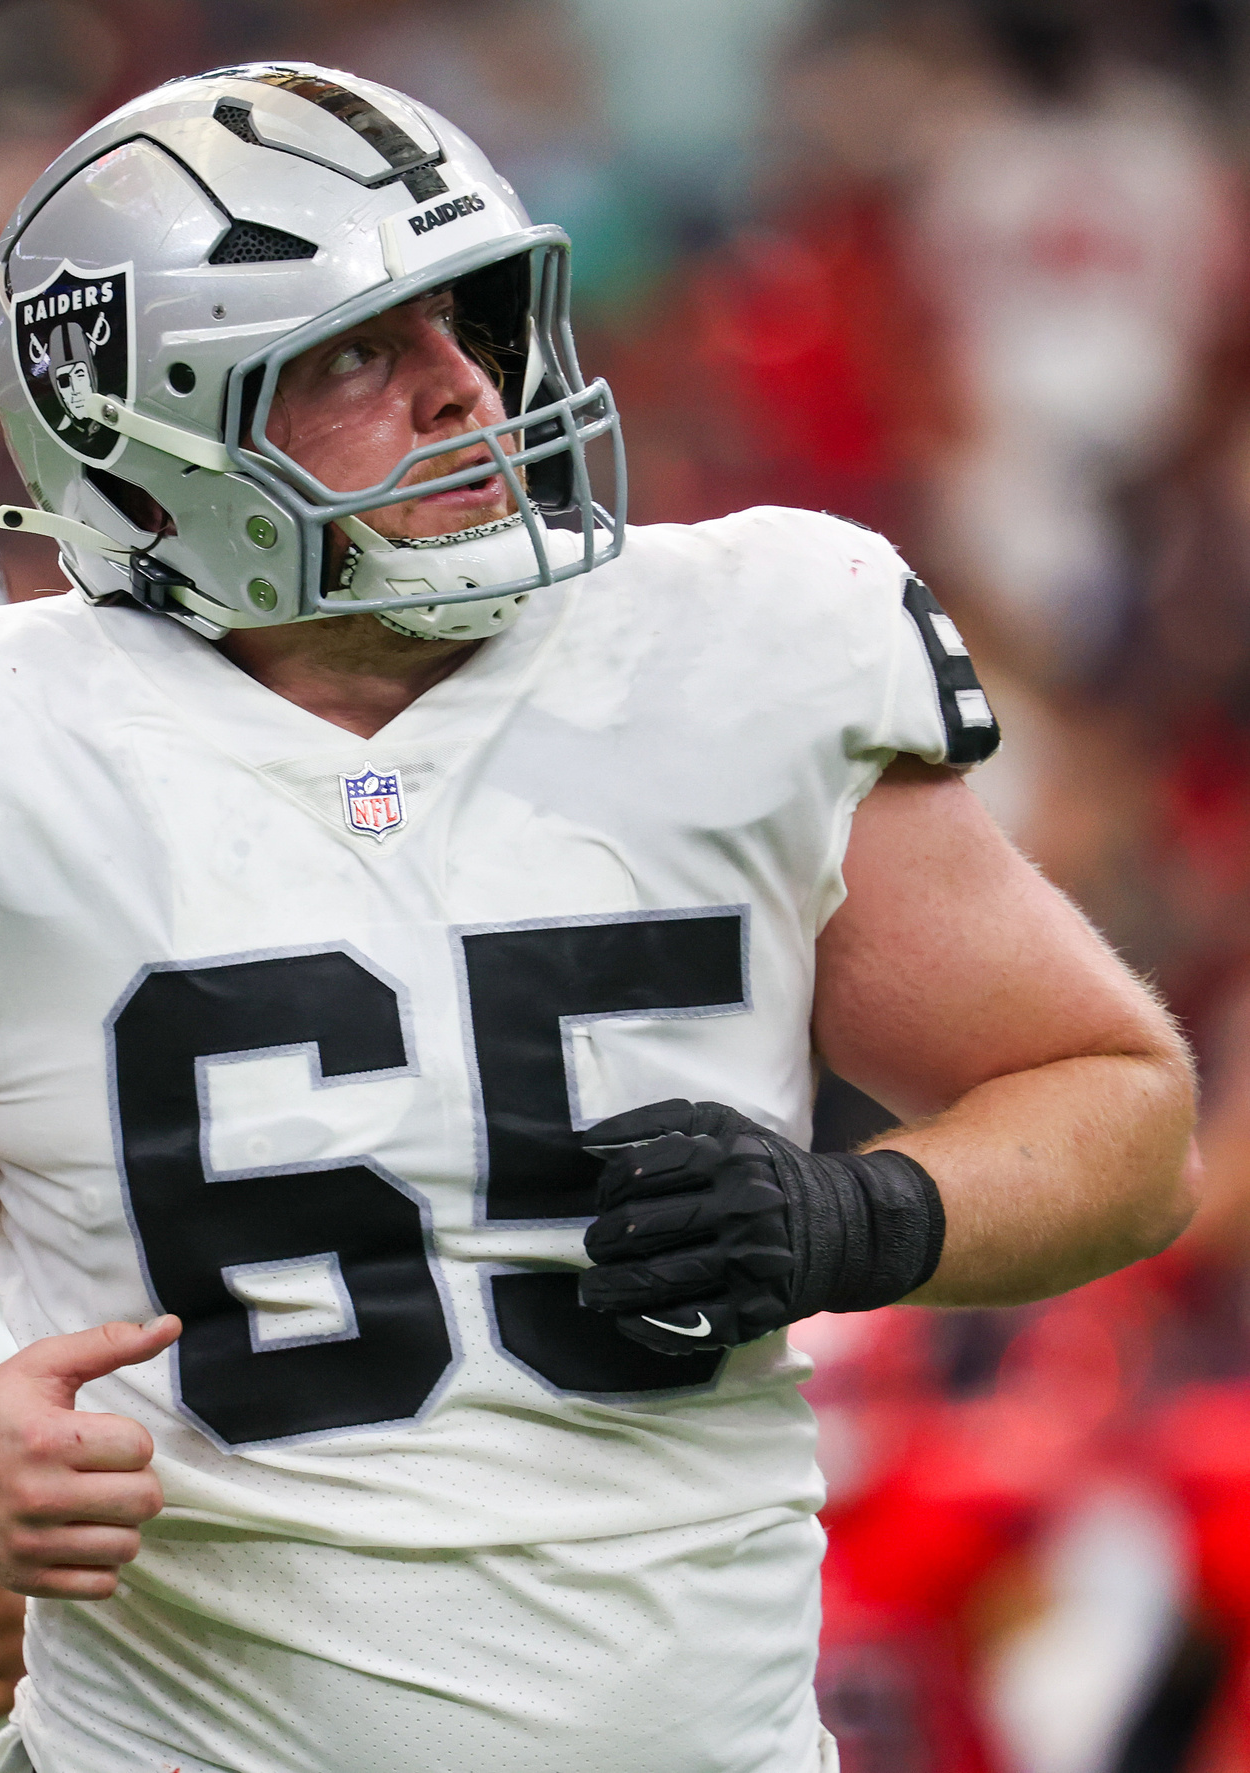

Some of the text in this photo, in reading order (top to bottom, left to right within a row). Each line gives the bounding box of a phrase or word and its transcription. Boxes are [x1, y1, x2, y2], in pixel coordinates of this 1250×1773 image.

[408, 192, 486, 236] RAIDERS
[23, 281, 114, 326] RAIDERS
[352, 797, 398, 828] NFL
[103, 903, 753, 1456] 65
